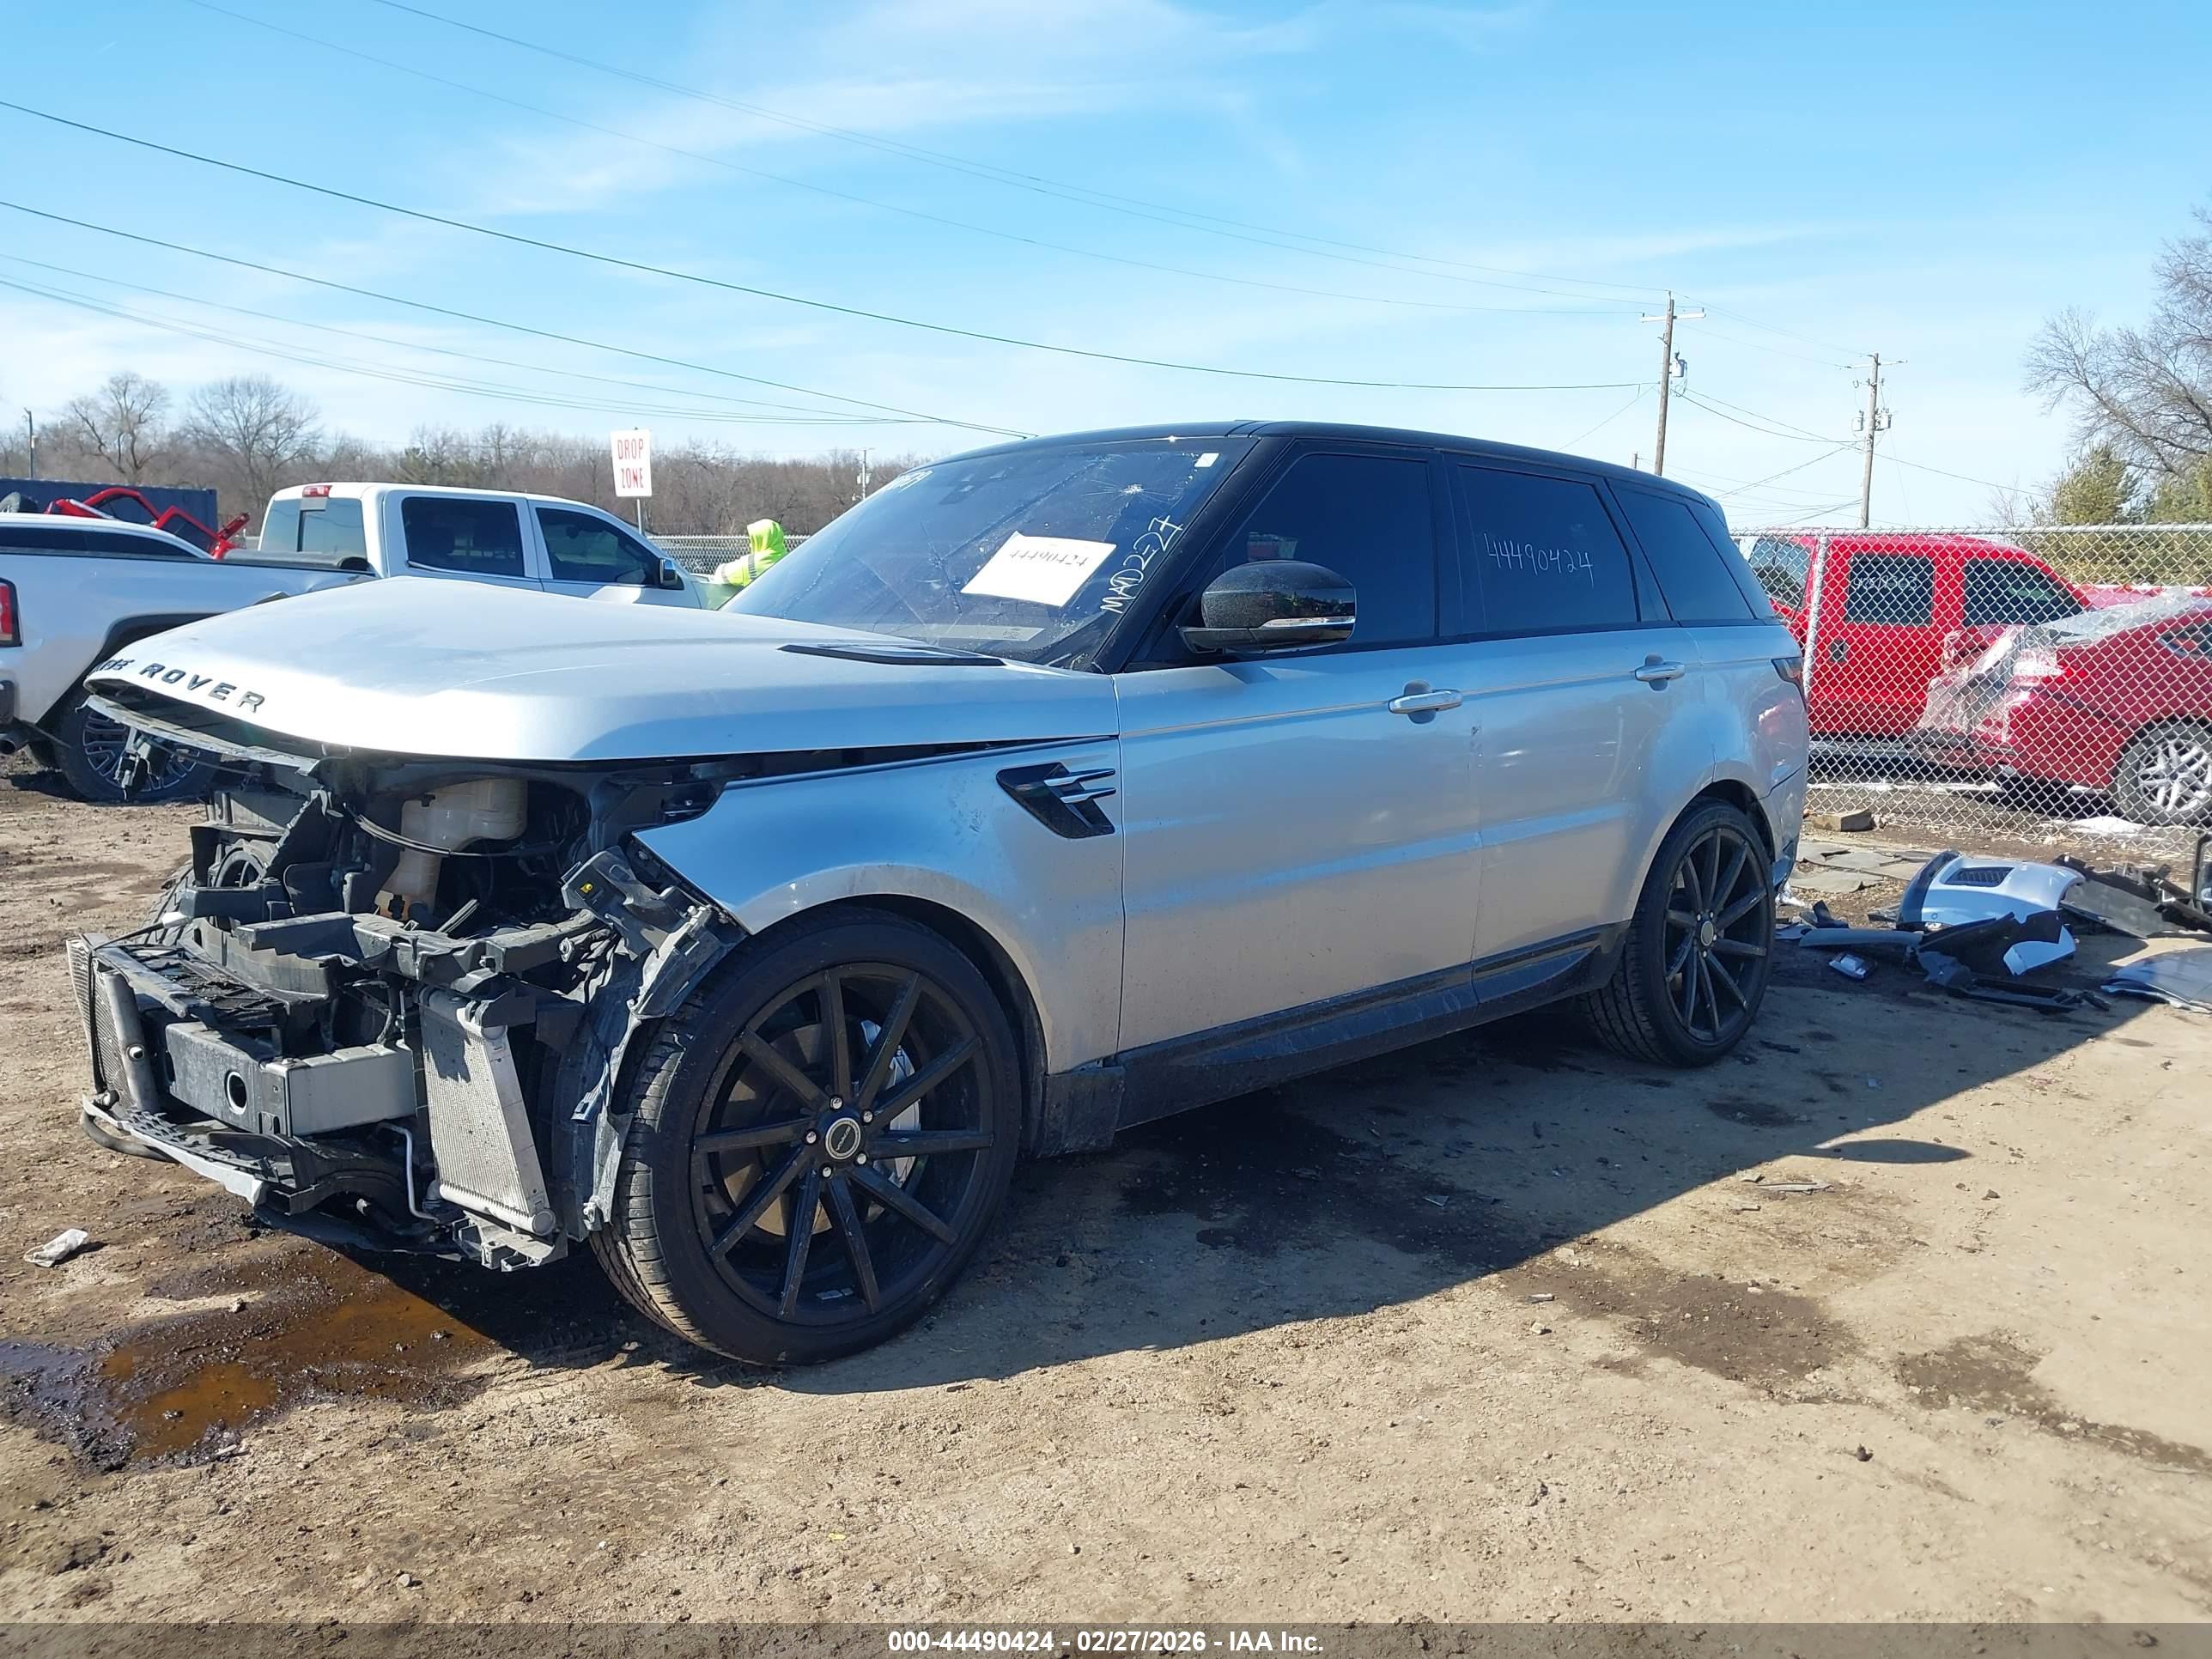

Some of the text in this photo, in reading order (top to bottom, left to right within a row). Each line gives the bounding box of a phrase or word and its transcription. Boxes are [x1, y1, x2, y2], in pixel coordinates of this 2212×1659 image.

[617, 439, 644, 459] DROP
[621, 468, 644, 489] ZONE
[1484, 532, 1594, 589] 44490424
[138, 662, 265, 714] ROVER
